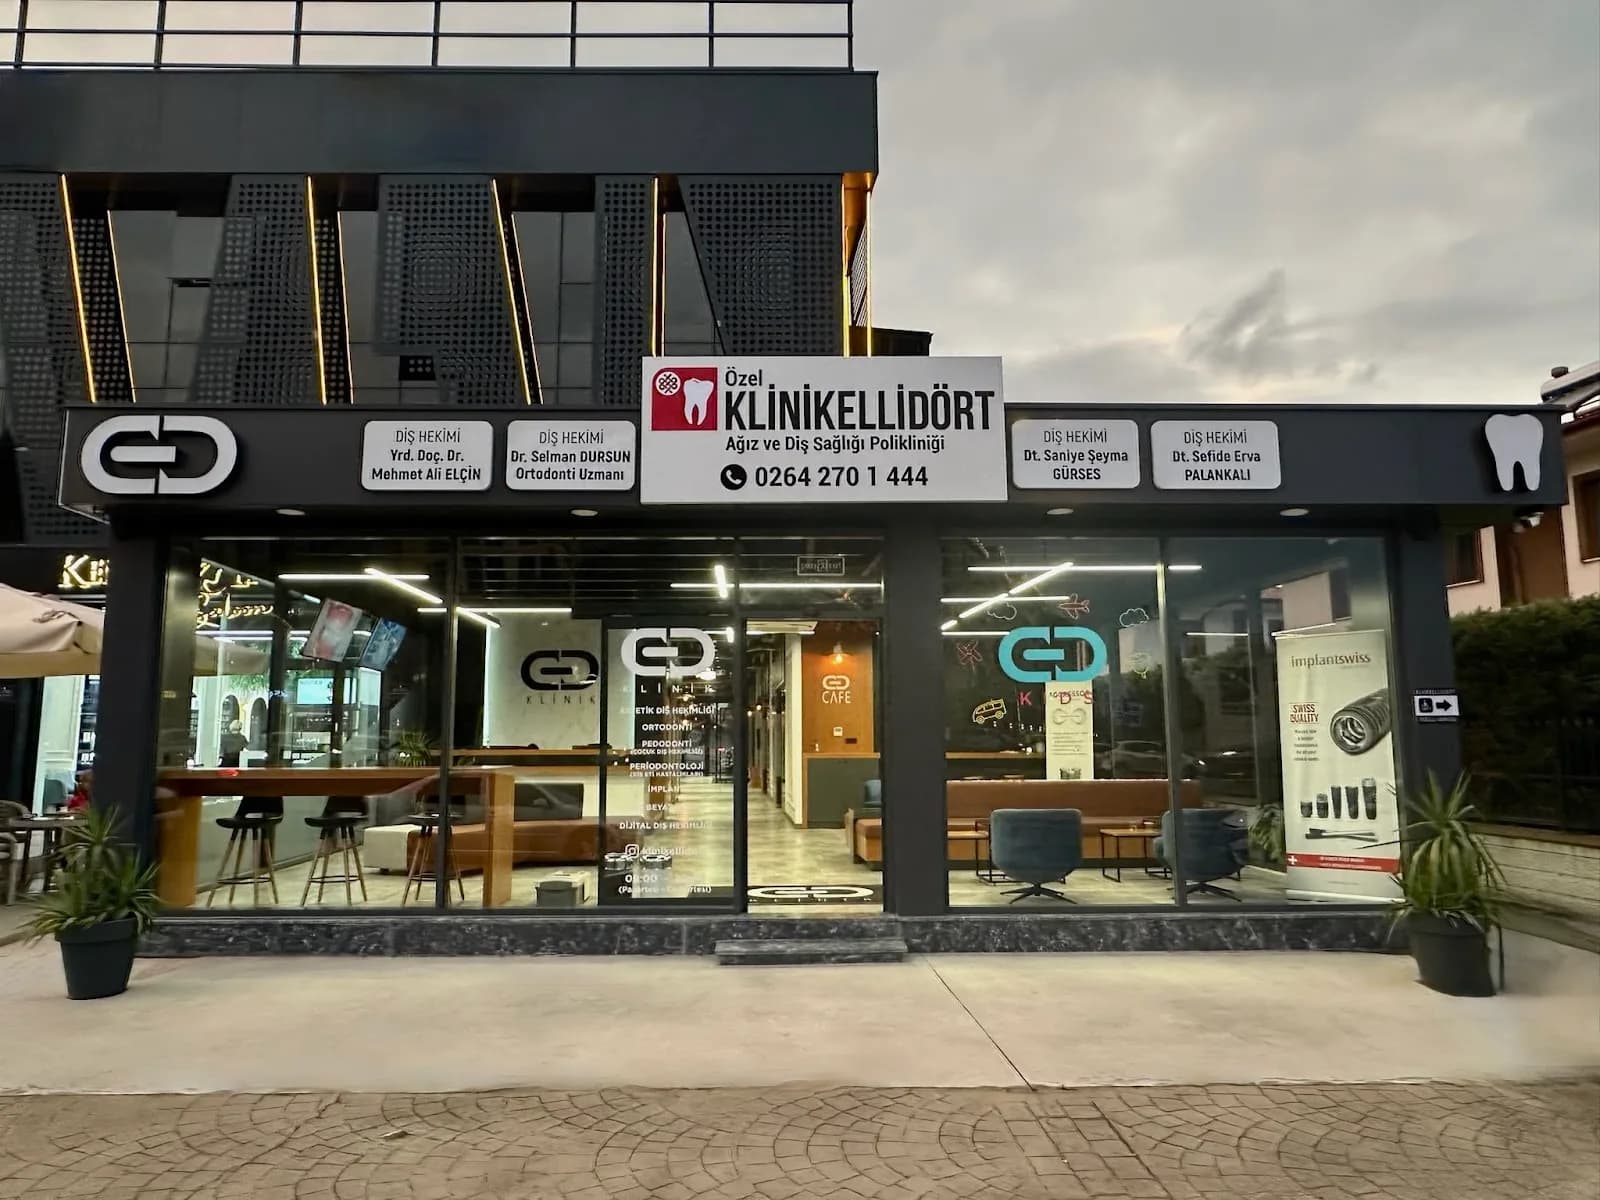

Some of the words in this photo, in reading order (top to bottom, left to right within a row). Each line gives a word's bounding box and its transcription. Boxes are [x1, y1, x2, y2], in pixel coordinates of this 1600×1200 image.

[725, 366, 763, 386] Özel
[725, 383, 995, 431] KLİNİKELLİDÖRT
[395, 427, 415, 444] DİŞ
[419, 427, 461, 443] HEKİMİ
[539, 428, 559, 446] DİŞ
[562, 428, 604, 444] HEKİMİ
[1043, 428, 1063, 446] DİŞ
[1066, 429, 1108, 443] HEKİMİ
[1183, 428, 1203, 447] DİŞ
[1206, 429, 1247, 444] HEKİMİ
[726, 436, 759, 453] Ağız
[763, 439, 781, 451] ve
[785, 436, 809, 454] Diş
[813, 435, 865, 454] Sağlığı
[870, 435, 945, 454] Polikliniği
[390, 449, 414, 462] Yrd.
[418, 449, 443, 464] Doç.
[447, 449, 465, 462] Dr.
[511, 451, 528, 463] Dr.
[531, 450, 576, 463] Selman
[580, 451, 631, 463] DURSUN
[1024, 449, 1041, 462] Dt.
[1044, 449, 1085, 464] Saniye
[1087, 449, 1128, 464] Şeyma
[1172, 450, 1189, 462] Dt.
[1192, 450, 1231, 462] Sefide
[1235, 451, 1261, 462] Erva
[372, 467, 423, 481] Mehmet
[426, 467, 441, 481] Ali
[445, 466, 481, 483] ELÇİN
[516, 467, 576, 481] Ortodonti
[579, 468, 624, 481] Uzmanı
[755, 466, 812, 487] 0264
[818, 466, 859, 487] 270
[868, 467, 877, 486] 1
[886, 466, 928, 486] 444
[1053, 465, 1101, 480] GÜRSES
[1185, 468, 1251, 481] PALANKALI
[822, 691, 851, 704] CAFE
[1293, 704, 1315, 713] SWISS
